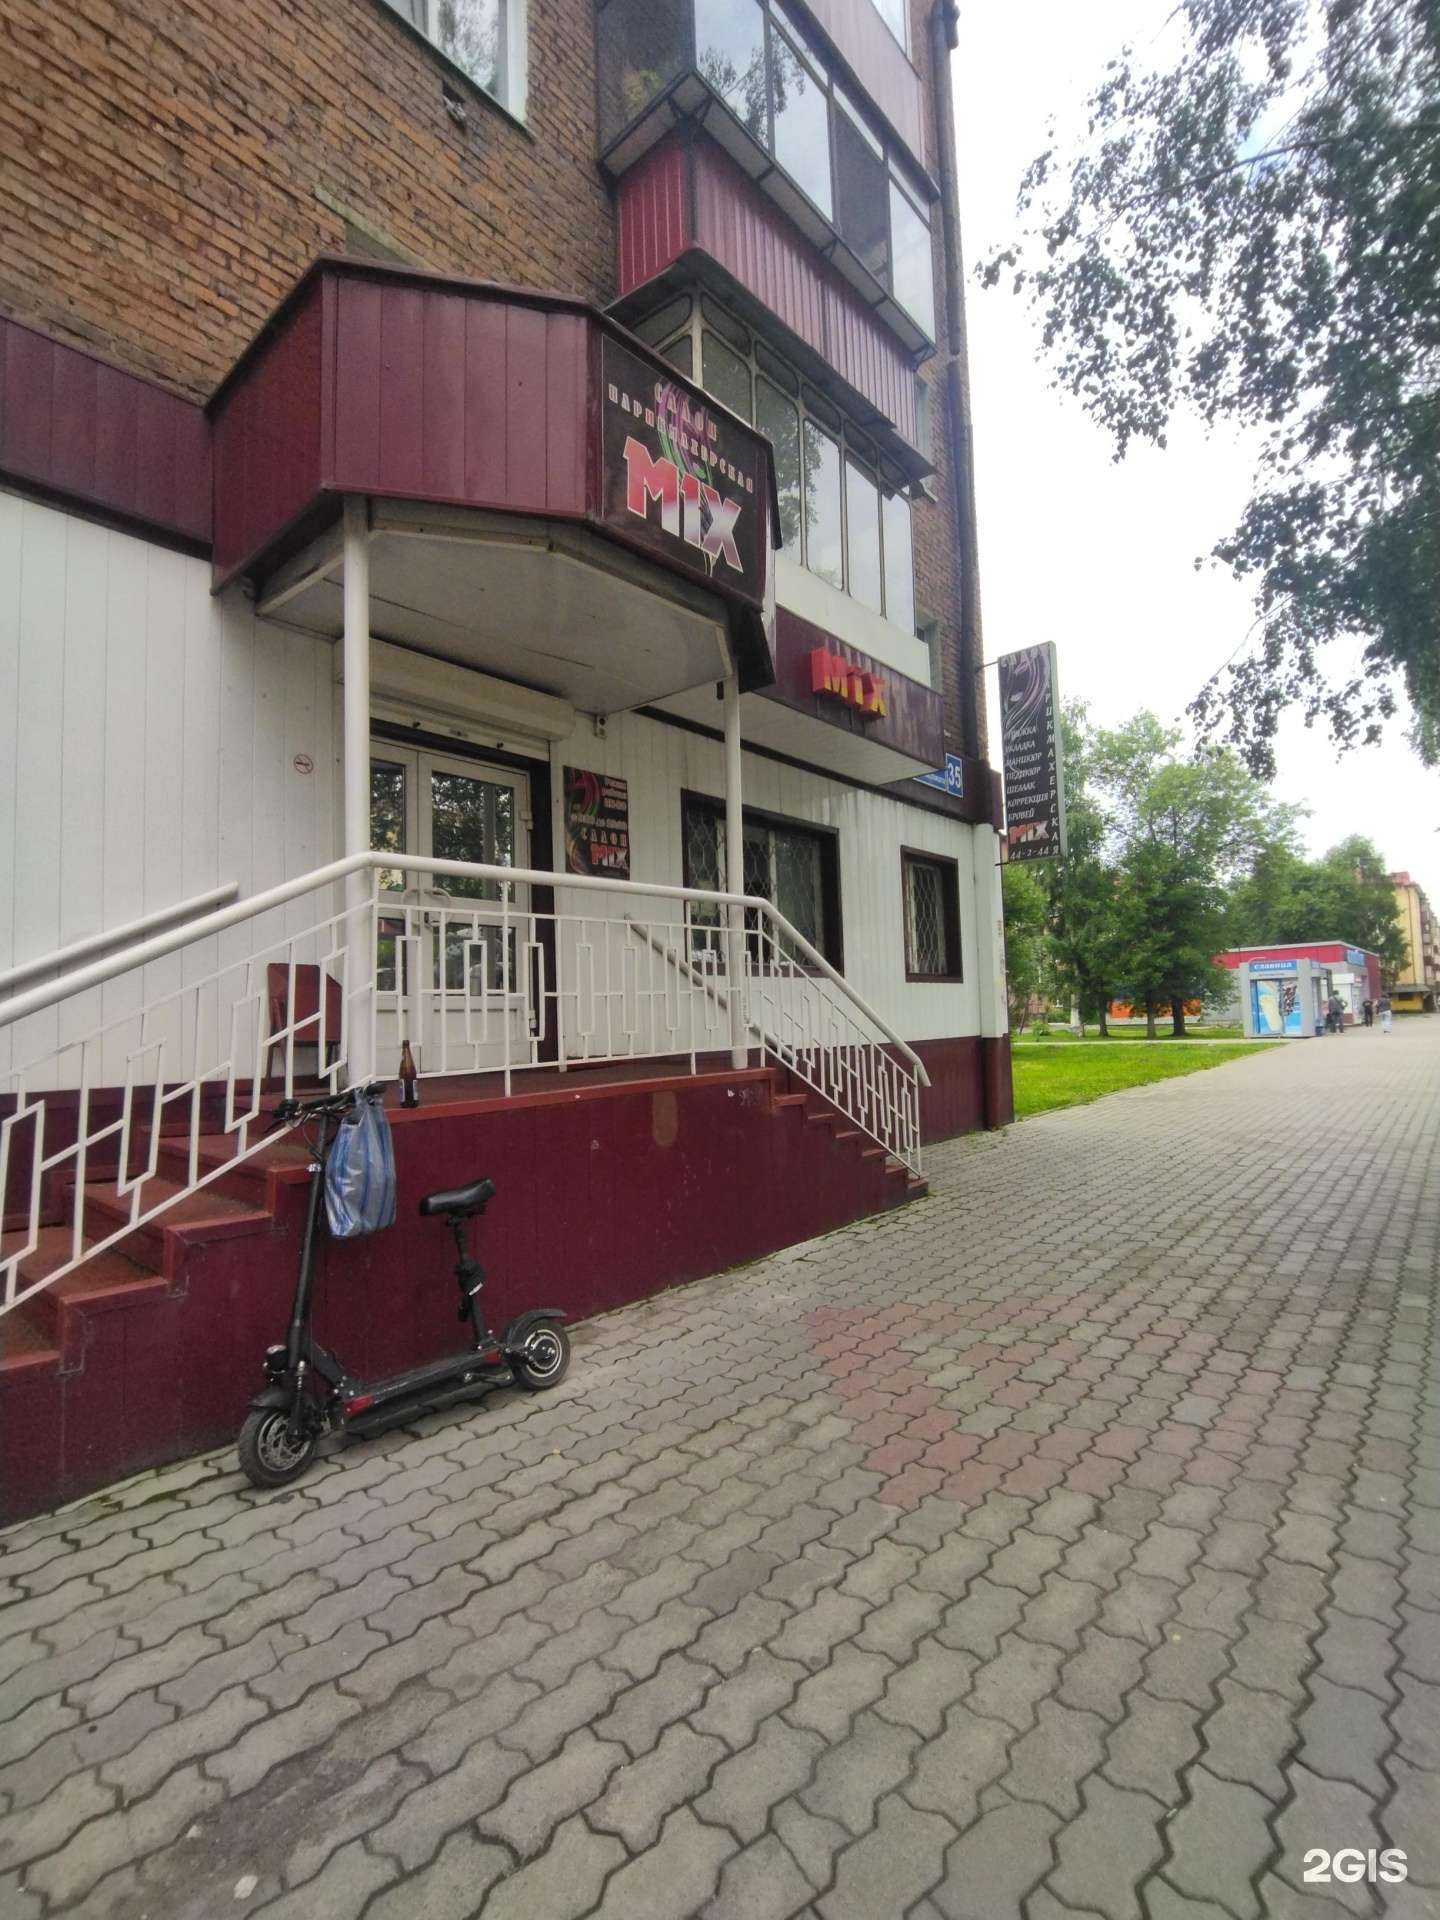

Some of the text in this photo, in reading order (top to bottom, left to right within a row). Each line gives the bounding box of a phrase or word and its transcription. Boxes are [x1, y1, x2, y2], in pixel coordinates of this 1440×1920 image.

[654, 382, 717, 442] САЛОН
[608, 383, 754, 494] ПАРИКМАХЕРСКАЯ
[947, 763, 961, 788] 35
[1007, 792, 1049, 808] КОРРЕКЦИЯ
